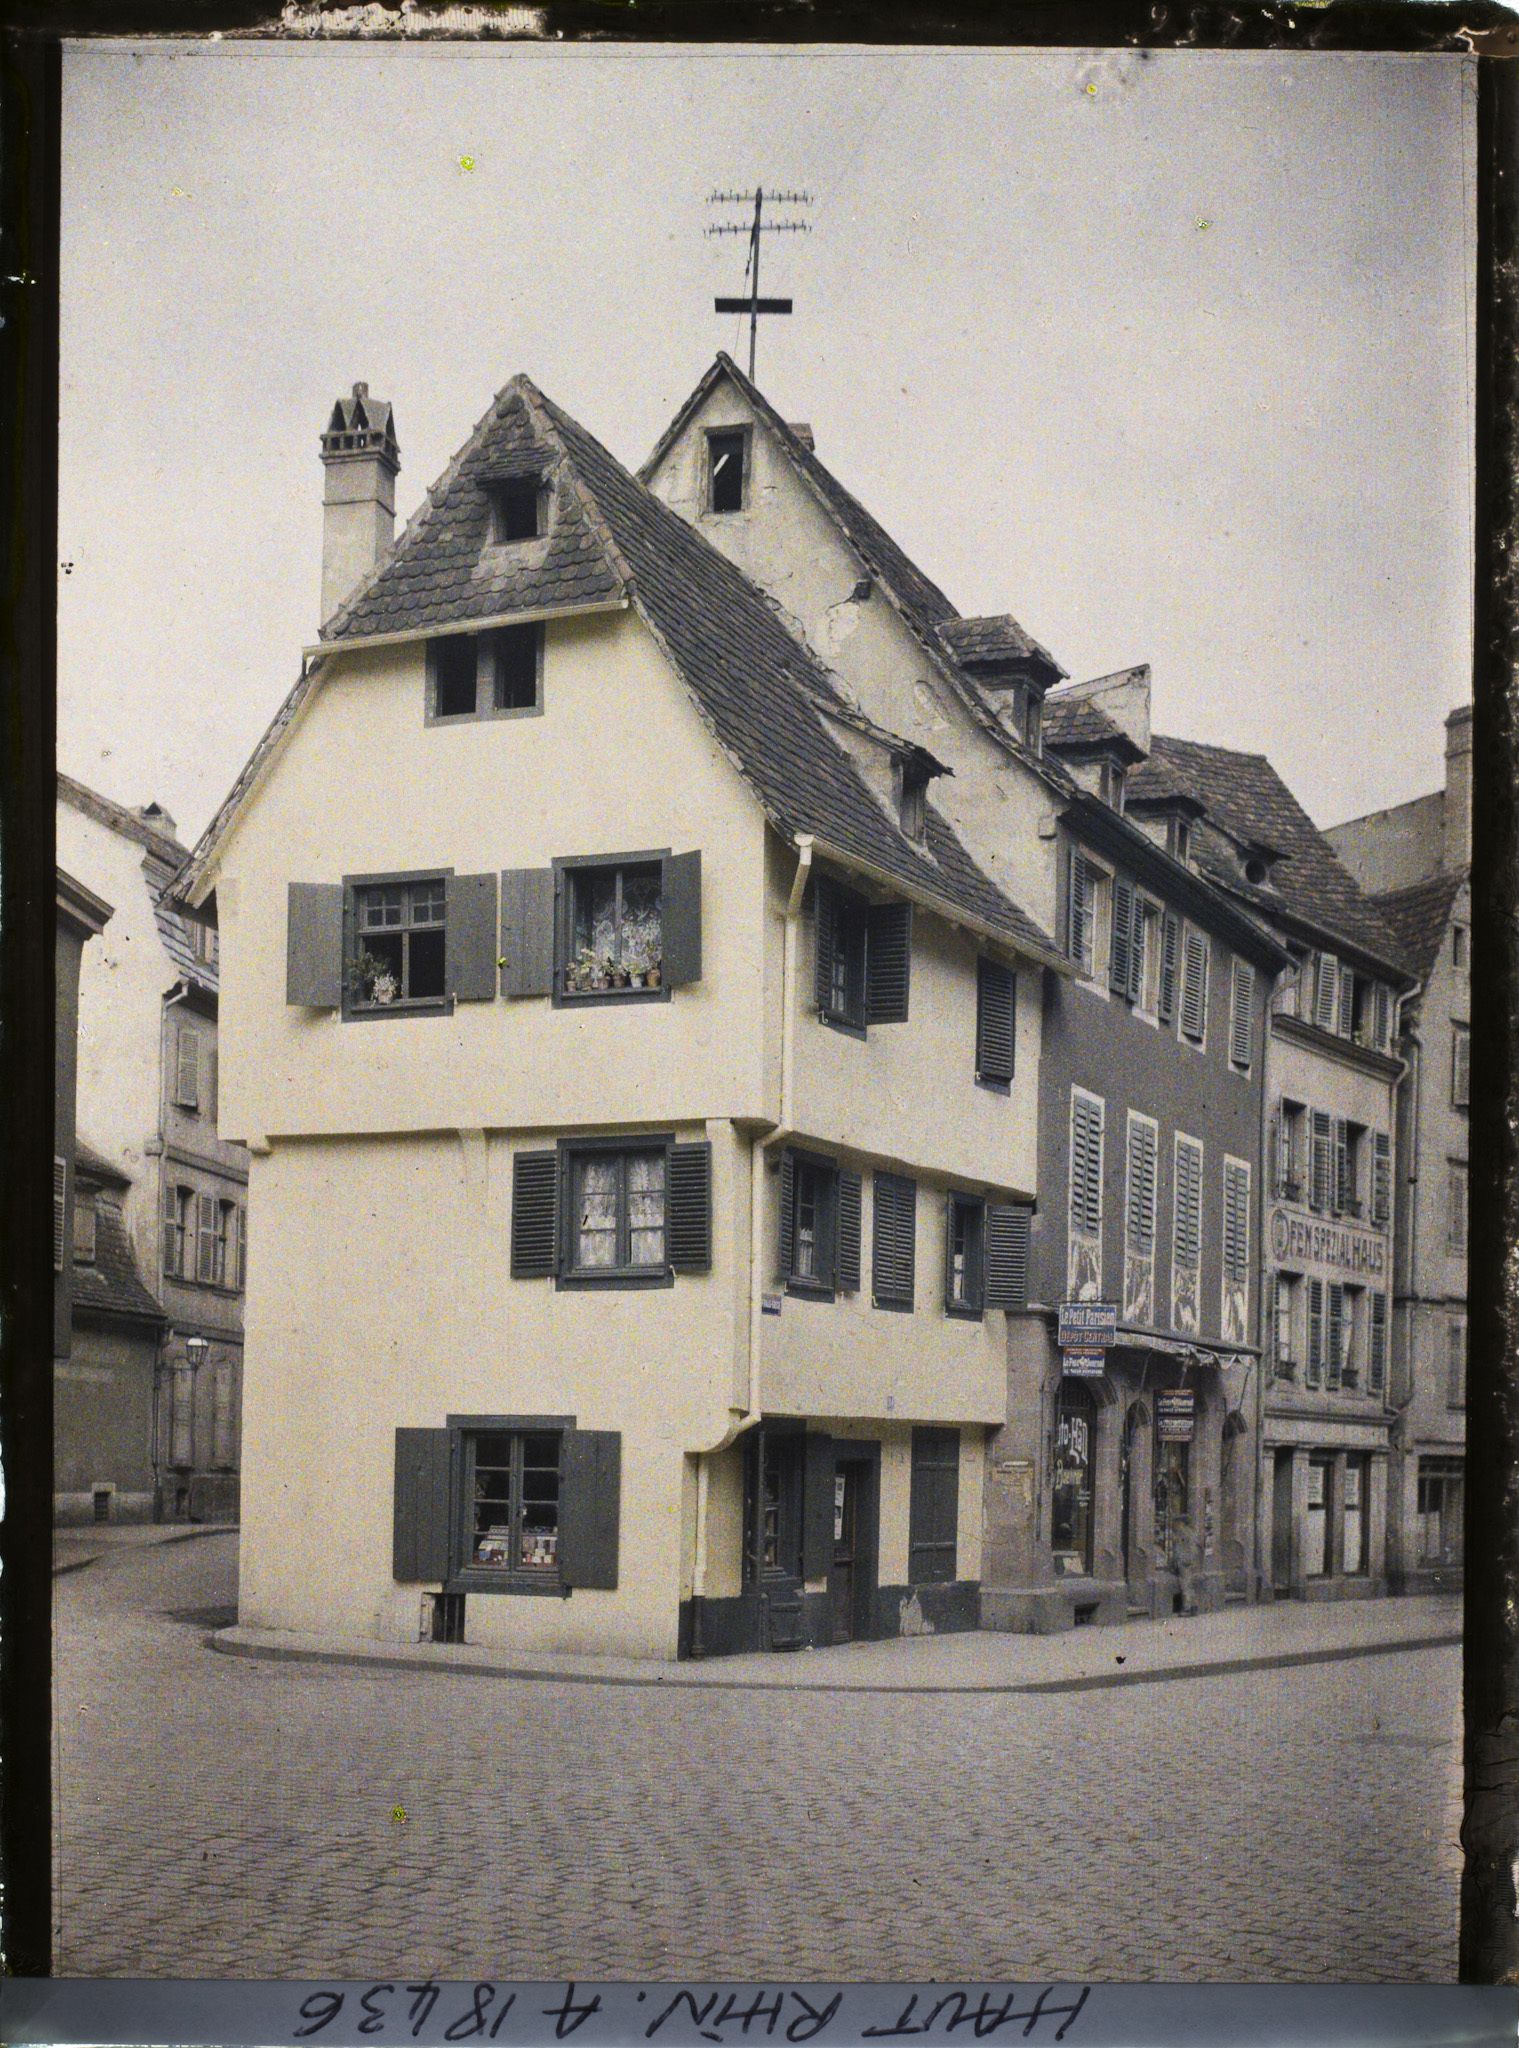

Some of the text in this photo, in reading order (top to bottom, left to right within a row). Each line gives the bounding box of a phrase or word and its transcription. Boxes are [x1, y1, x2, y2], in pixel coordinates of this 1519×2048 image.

[1352, 1236, 1383, 1275] HAUS
[1060, 1308, 1115, 1325] Le Petit Parisien
[542, 1981, 602, 2040] A
[862, 1985, 1091, 2041] HAUT
